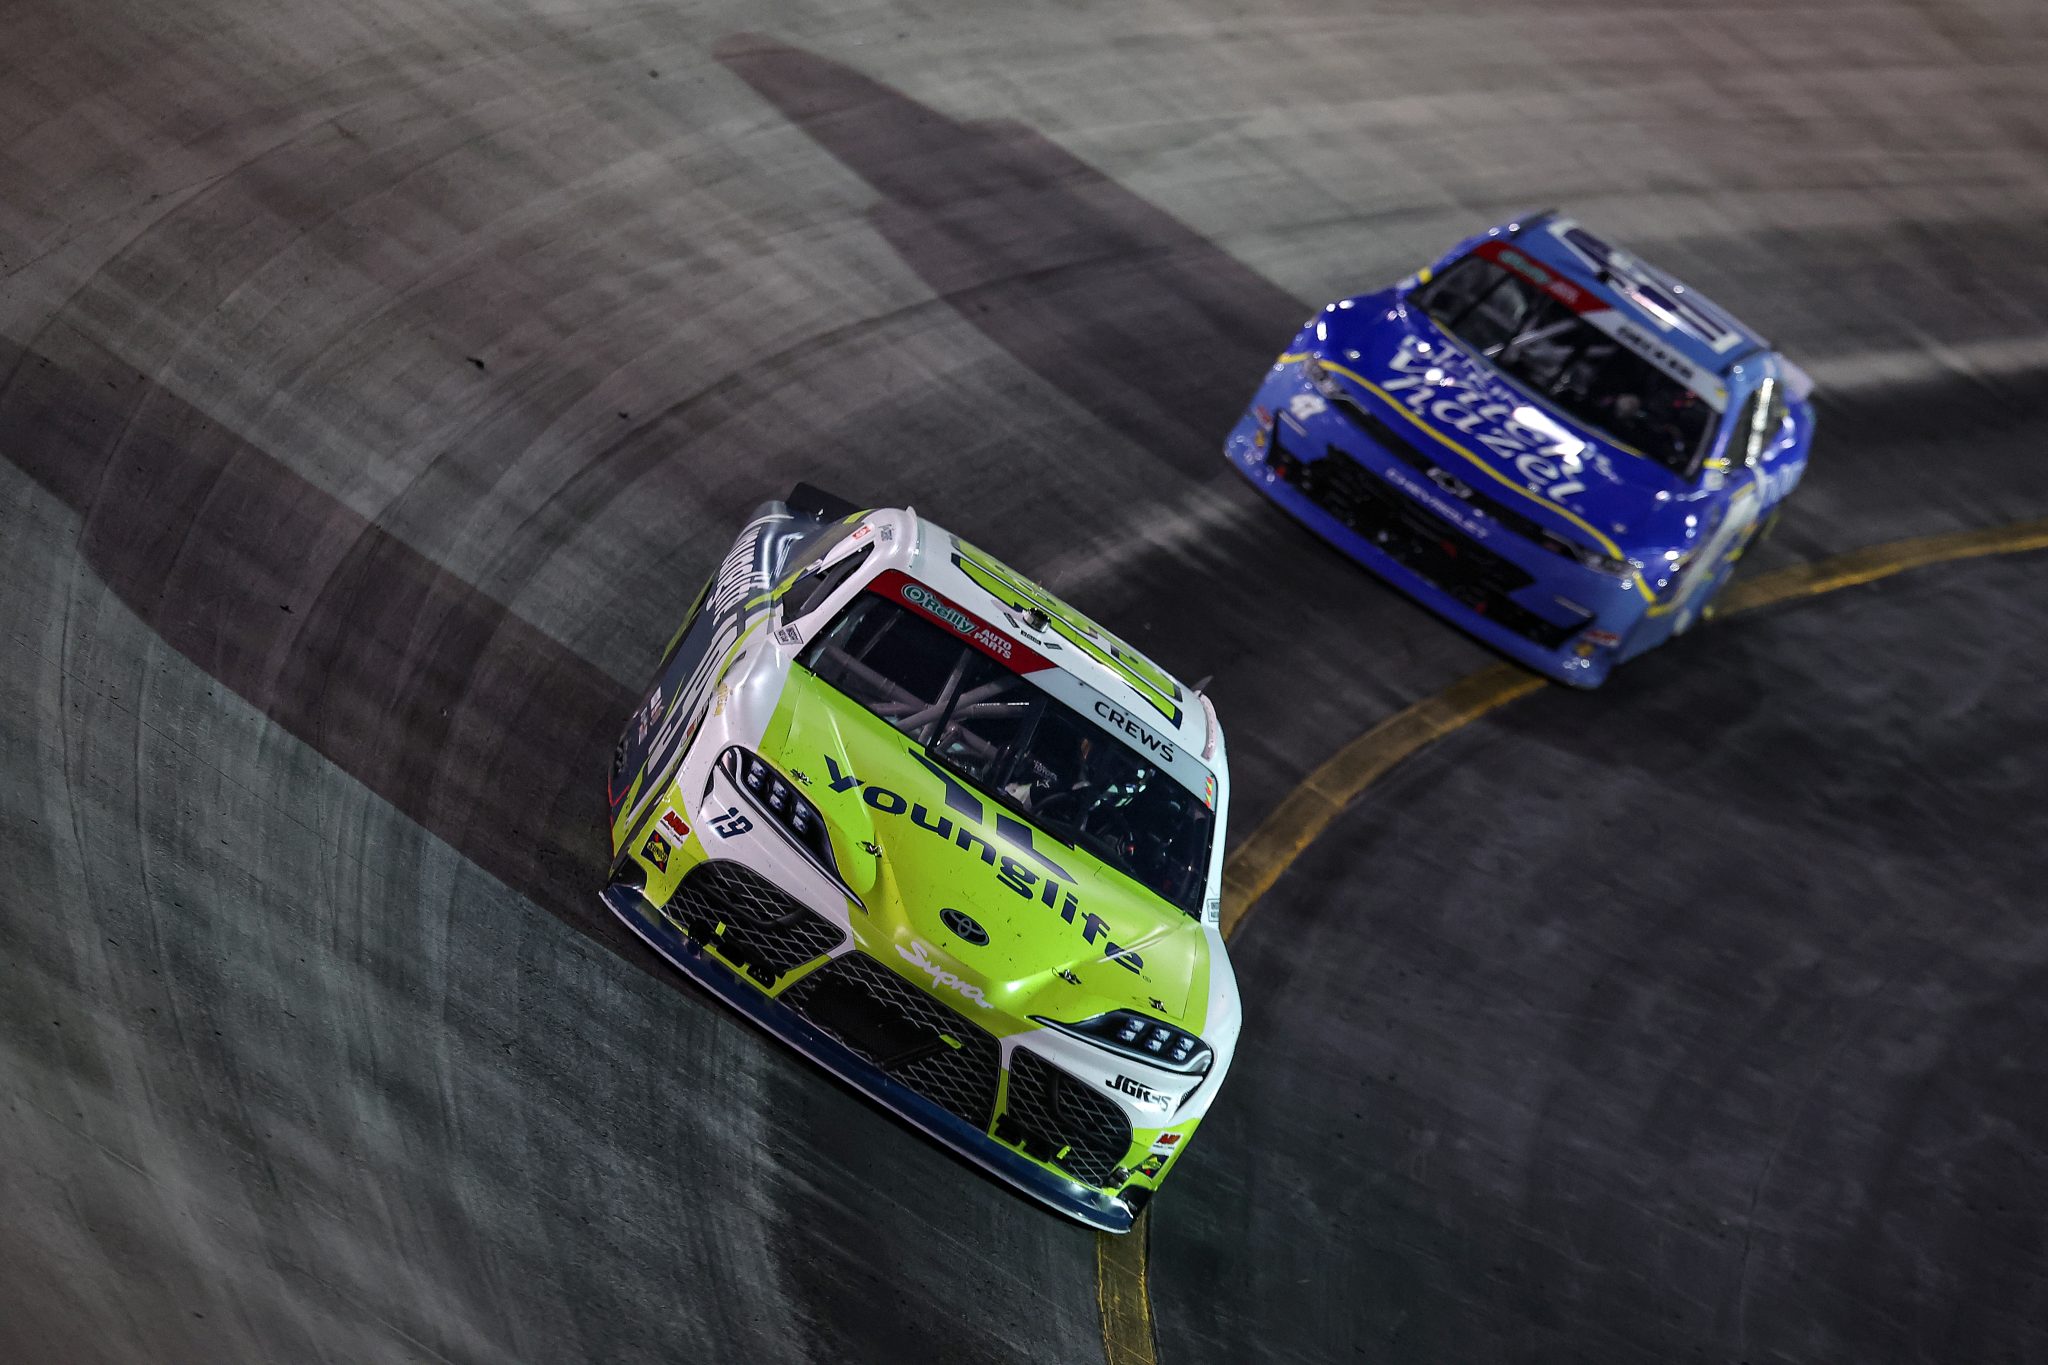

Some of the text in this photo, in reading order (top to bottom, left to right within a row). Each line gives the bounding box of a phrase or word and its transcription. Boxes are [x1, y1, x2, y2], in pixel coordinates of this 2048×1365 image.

[902, 584, 978, 634] O'Reilly
[974, 632, 1011, 659] PARTS
[981, 628, 1012, 651] AUTO
[1094, 701, 1174, 763] CREWS
[707, 807, 754, 839] 19
[824, 754, 1144, 976] younglife
[895, 940, 994, 1009] Supra
